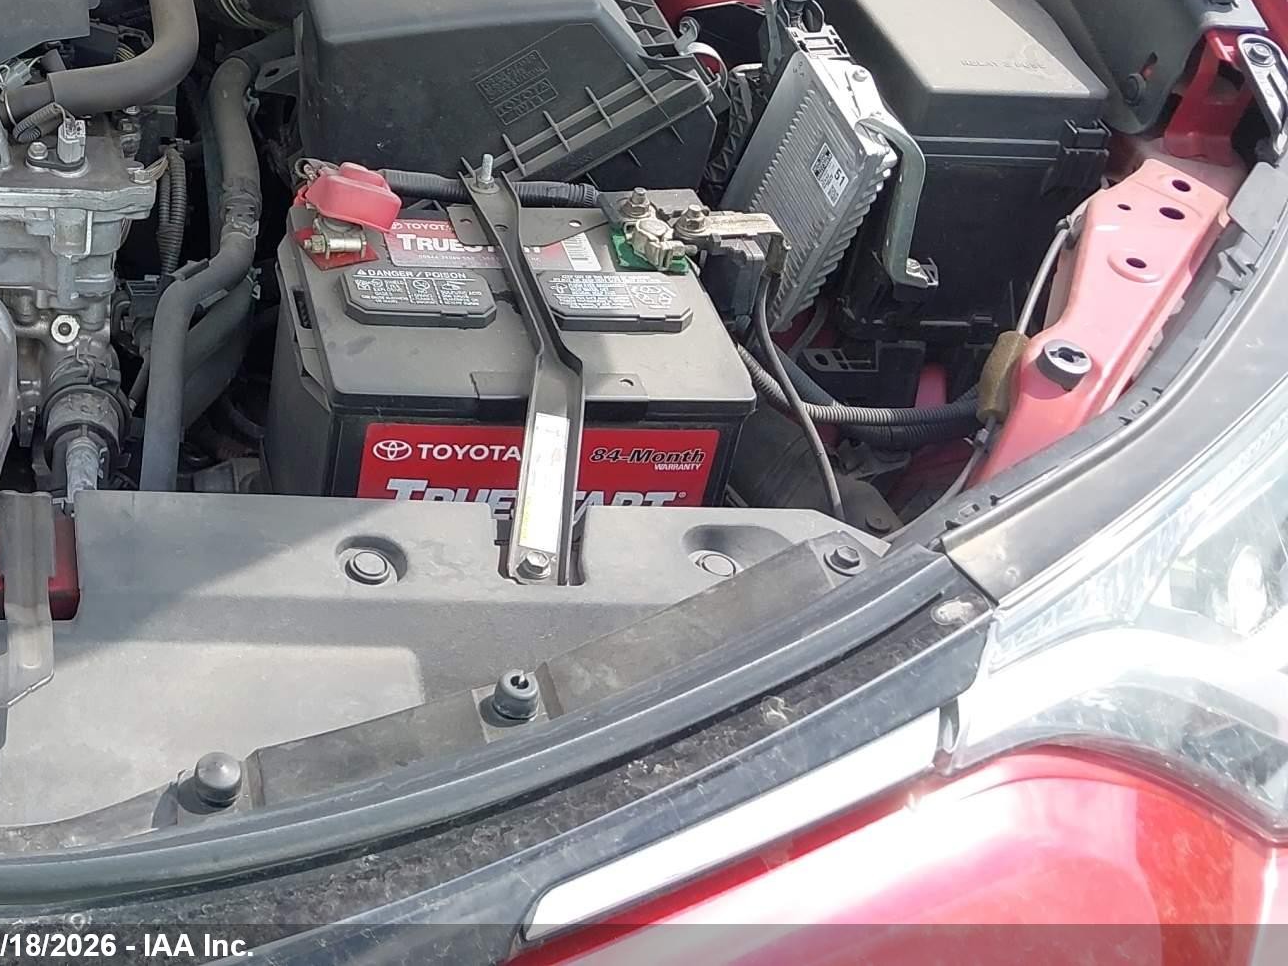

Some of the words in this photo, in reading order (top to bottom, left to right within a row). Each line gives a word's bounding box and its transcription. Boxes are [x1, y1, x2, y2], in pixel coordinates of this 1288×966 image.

[367, 269, 414, 277] DANGER
[424, 271, 467, 279] POISON
[417, 443, 522, 461] TOYOTA
[590, 447, 705, 464] 84-Month
[654, 463, 701, 471] WARRANTY
